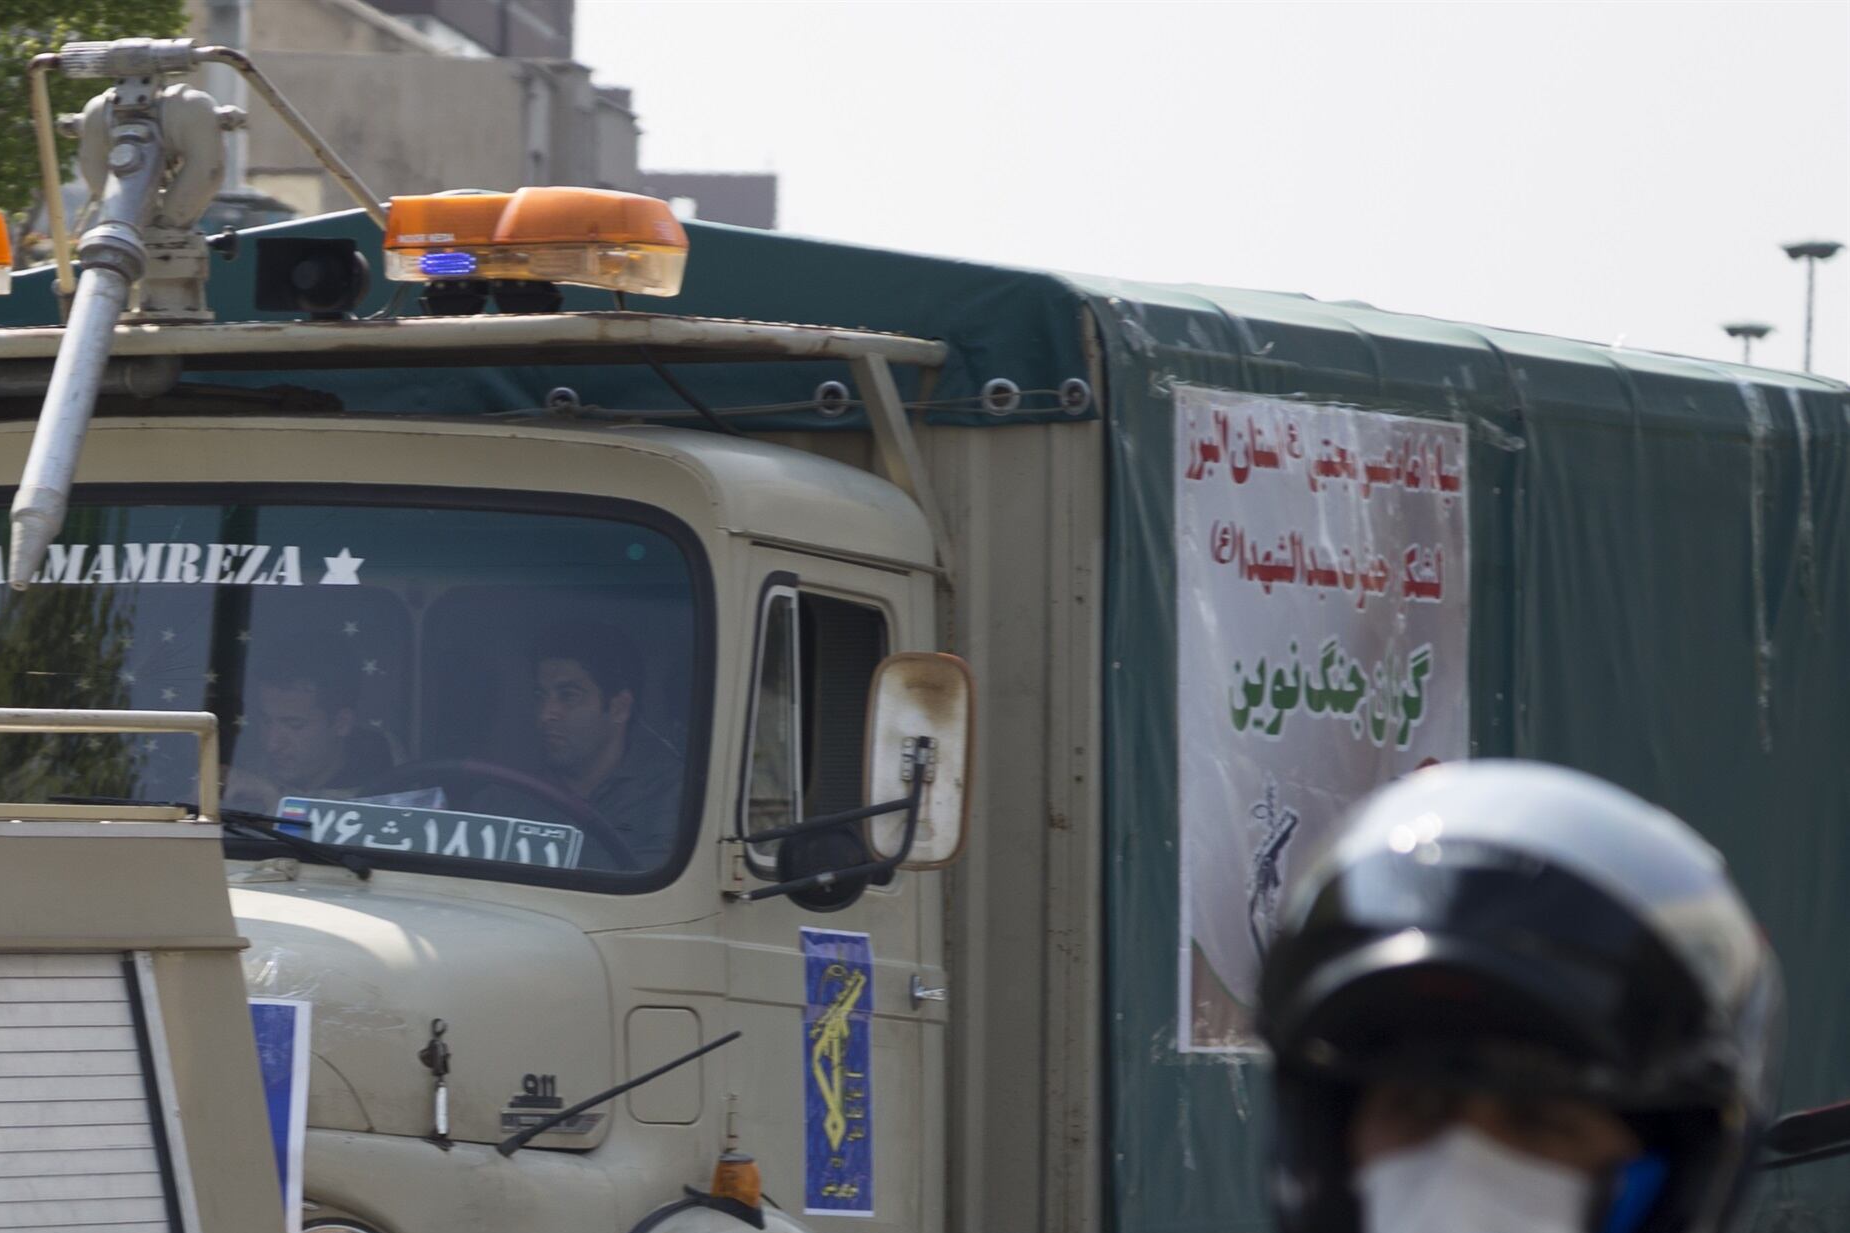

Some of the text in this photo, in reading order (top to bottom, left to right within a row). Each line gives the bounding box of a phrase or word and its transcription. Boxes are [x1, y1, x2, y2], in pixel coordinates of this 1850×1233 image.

[1230, 413, 1283, 484] استان
[1229, 641, 1300, 736] نوین
[1305, 640, 1367, 731] جنگ
[522, 1073, 556, 1097] 911
